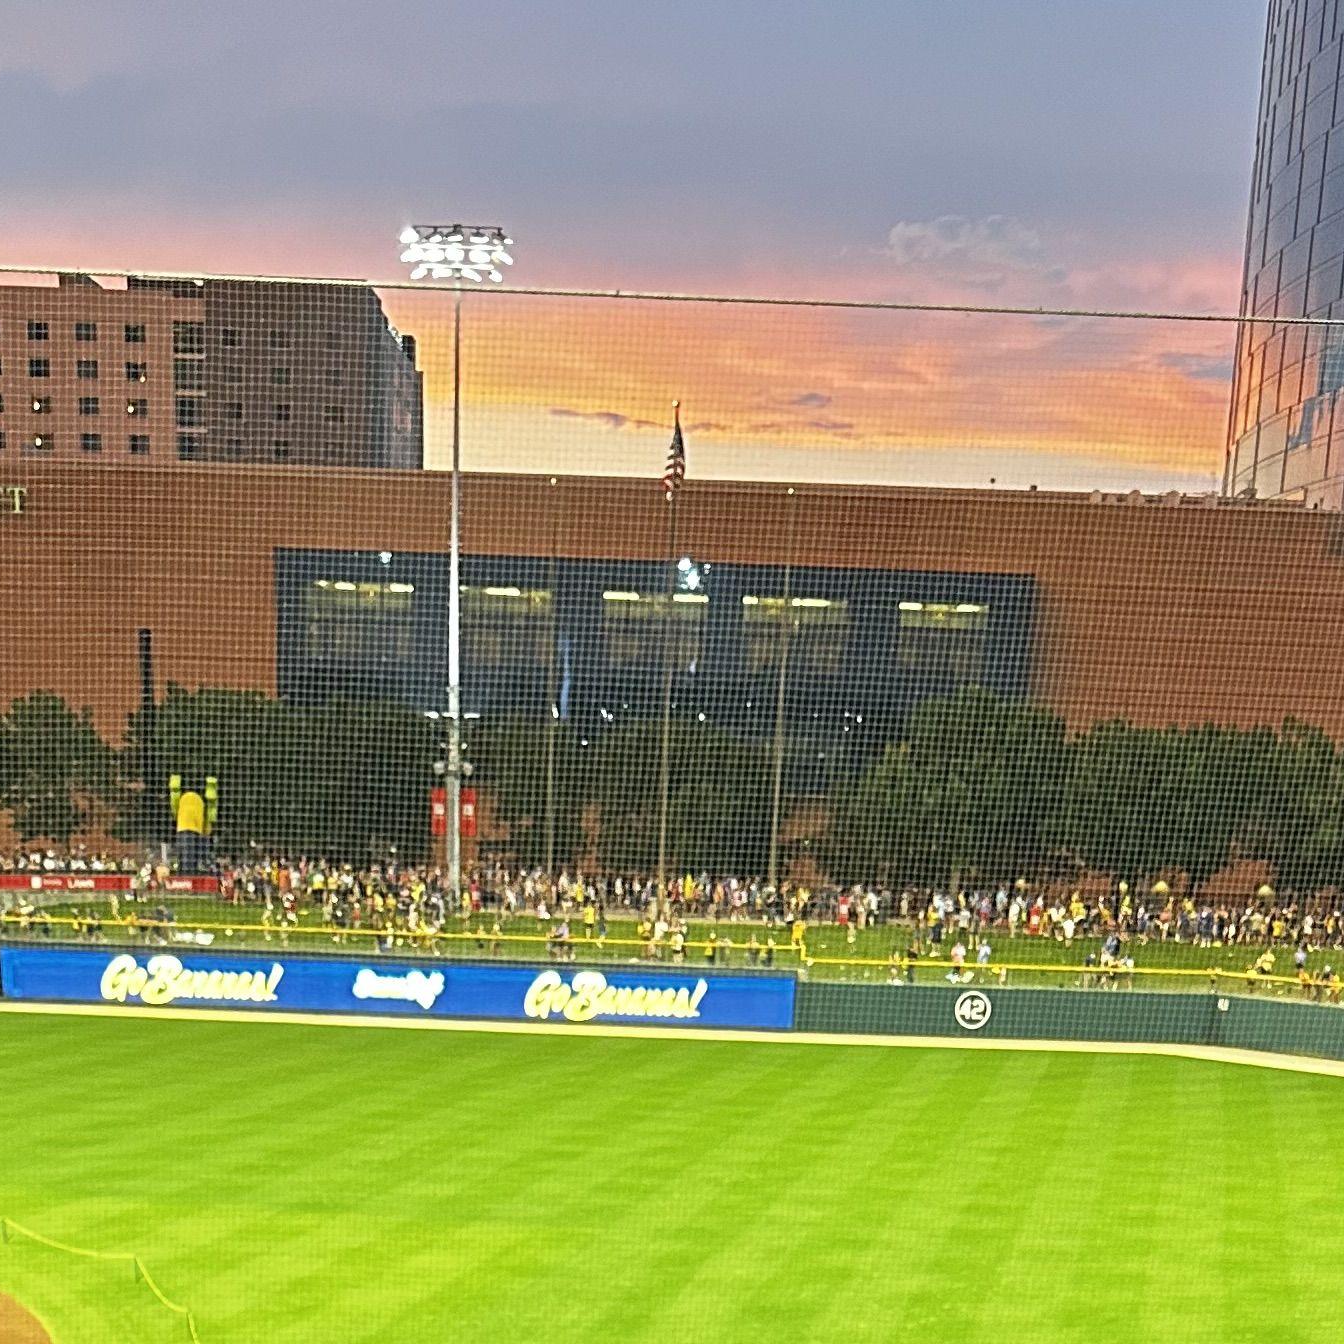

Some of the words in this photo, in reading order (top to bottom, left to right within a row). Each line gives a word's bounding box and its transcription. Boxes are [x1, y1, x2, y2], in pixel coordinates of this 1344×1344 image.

[100, 954, 147, 1002] Go
[140, 955, 285, 1005] Bananas!
[524, 970, 572, 1020] Go
[563, 971, 708, 1022] Bananas!
[959, 998, 985, 1020] 42
